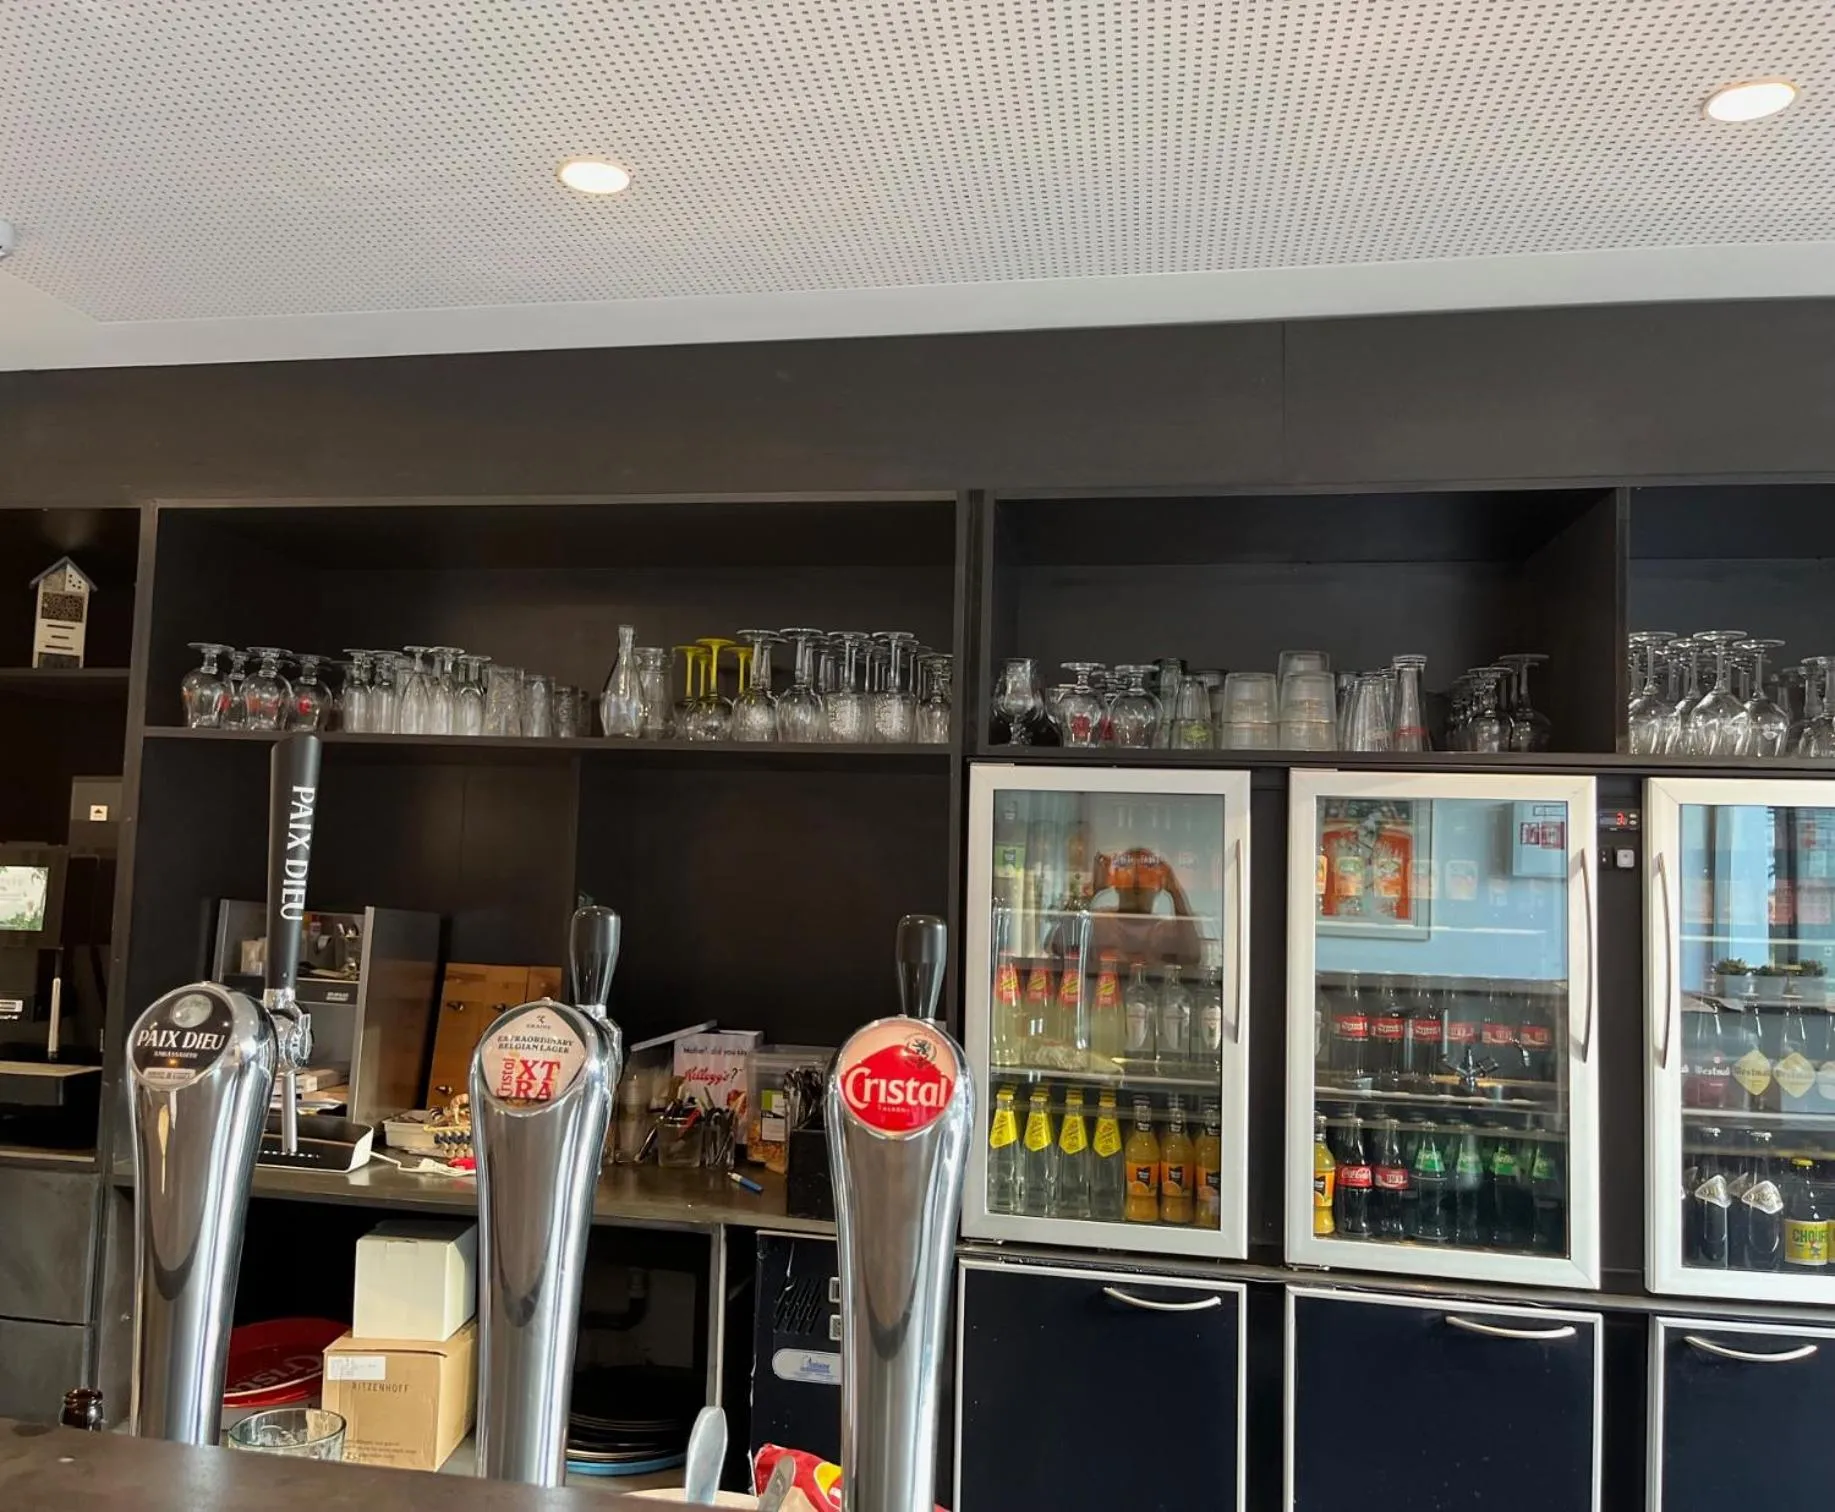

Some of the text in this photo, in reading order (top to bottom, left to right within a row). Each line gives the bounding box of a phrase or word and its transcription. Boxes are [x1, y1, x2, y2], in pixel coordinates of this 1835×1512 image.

[280, 786, 315, 920] PAIX DIEU
[137, 1030, 225, 1050] PAIX DIEU
[498, 1043, 570, 1054] BELGIAN LAGER
[516, 1058, 561, 1081] XT
[515, 1080, 553, 1098] RA
[845, 1066, 949, 1110] Cristal
[351, 1381, 411, 1394] RITZENHOFF
